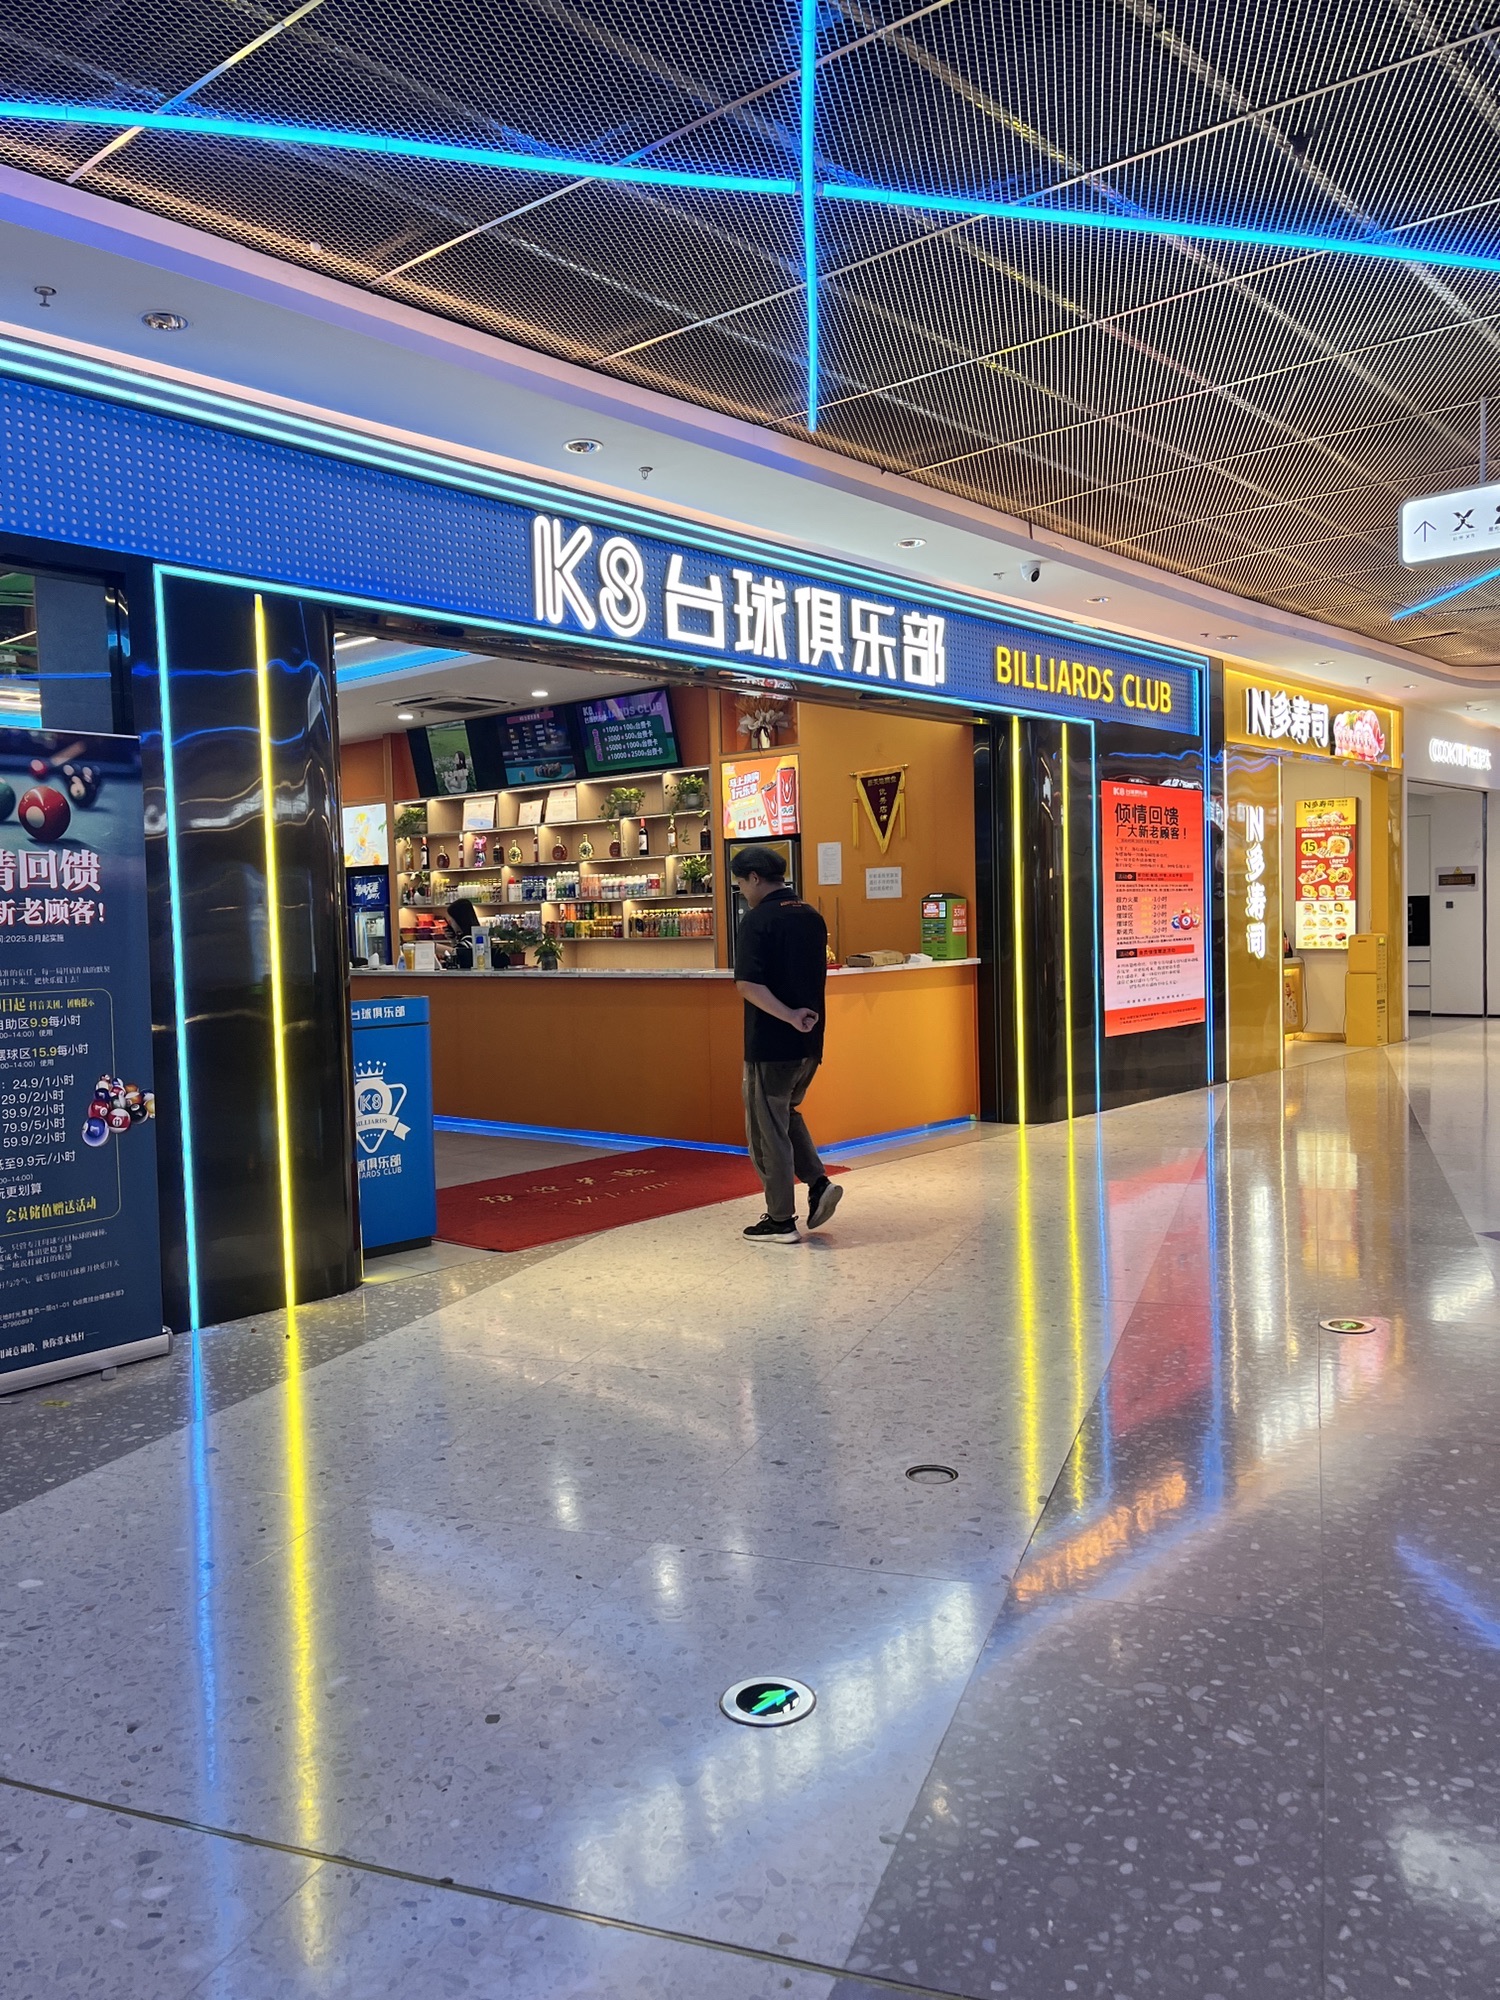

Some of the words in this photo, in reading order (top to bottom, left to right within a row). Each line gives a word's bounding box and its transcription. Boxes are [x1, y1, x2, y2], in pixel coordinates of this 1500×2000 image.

[533, 515, 946, 687] K8台球俱乐部
[996, 646, 1114, 703] BILLIARDS
[1121, 673, 1172, 713] CLUB
[637, 701, 663, 714] CLUB
[1246, 688, 1330, 748] N多寿司
[1113, 787, 1125, 796] K8
[1304, 800, 1334, 809] N多寿司
[738, 814, 767, 831] 40%
[1115, 803, 1179, 826] 倾情回馈
[1116, 824, 1187, 840] 广大新老顾客！
[1304, 842, 1316, 851] 15
[1245, 805, 1267, 959] N多寿司
[0, 976, 80, 986] 打下来，把快乐提上去！
[0, 998, 26, 1012] 日起
[351, 1005, 406, 1020] 台球俱乐部
[1, 1089, 64, 1105] 29.9/2小时
[360, 1093, 382, 1112] K8
[2, 1103, 65, 1119] 39.9/2小时
[3, 1117, 66, 1133] 79.9/5小时
[3, 1131, 66, 1148] 59.9/2小时
[383, 1166, 402, 1176] CLUB
